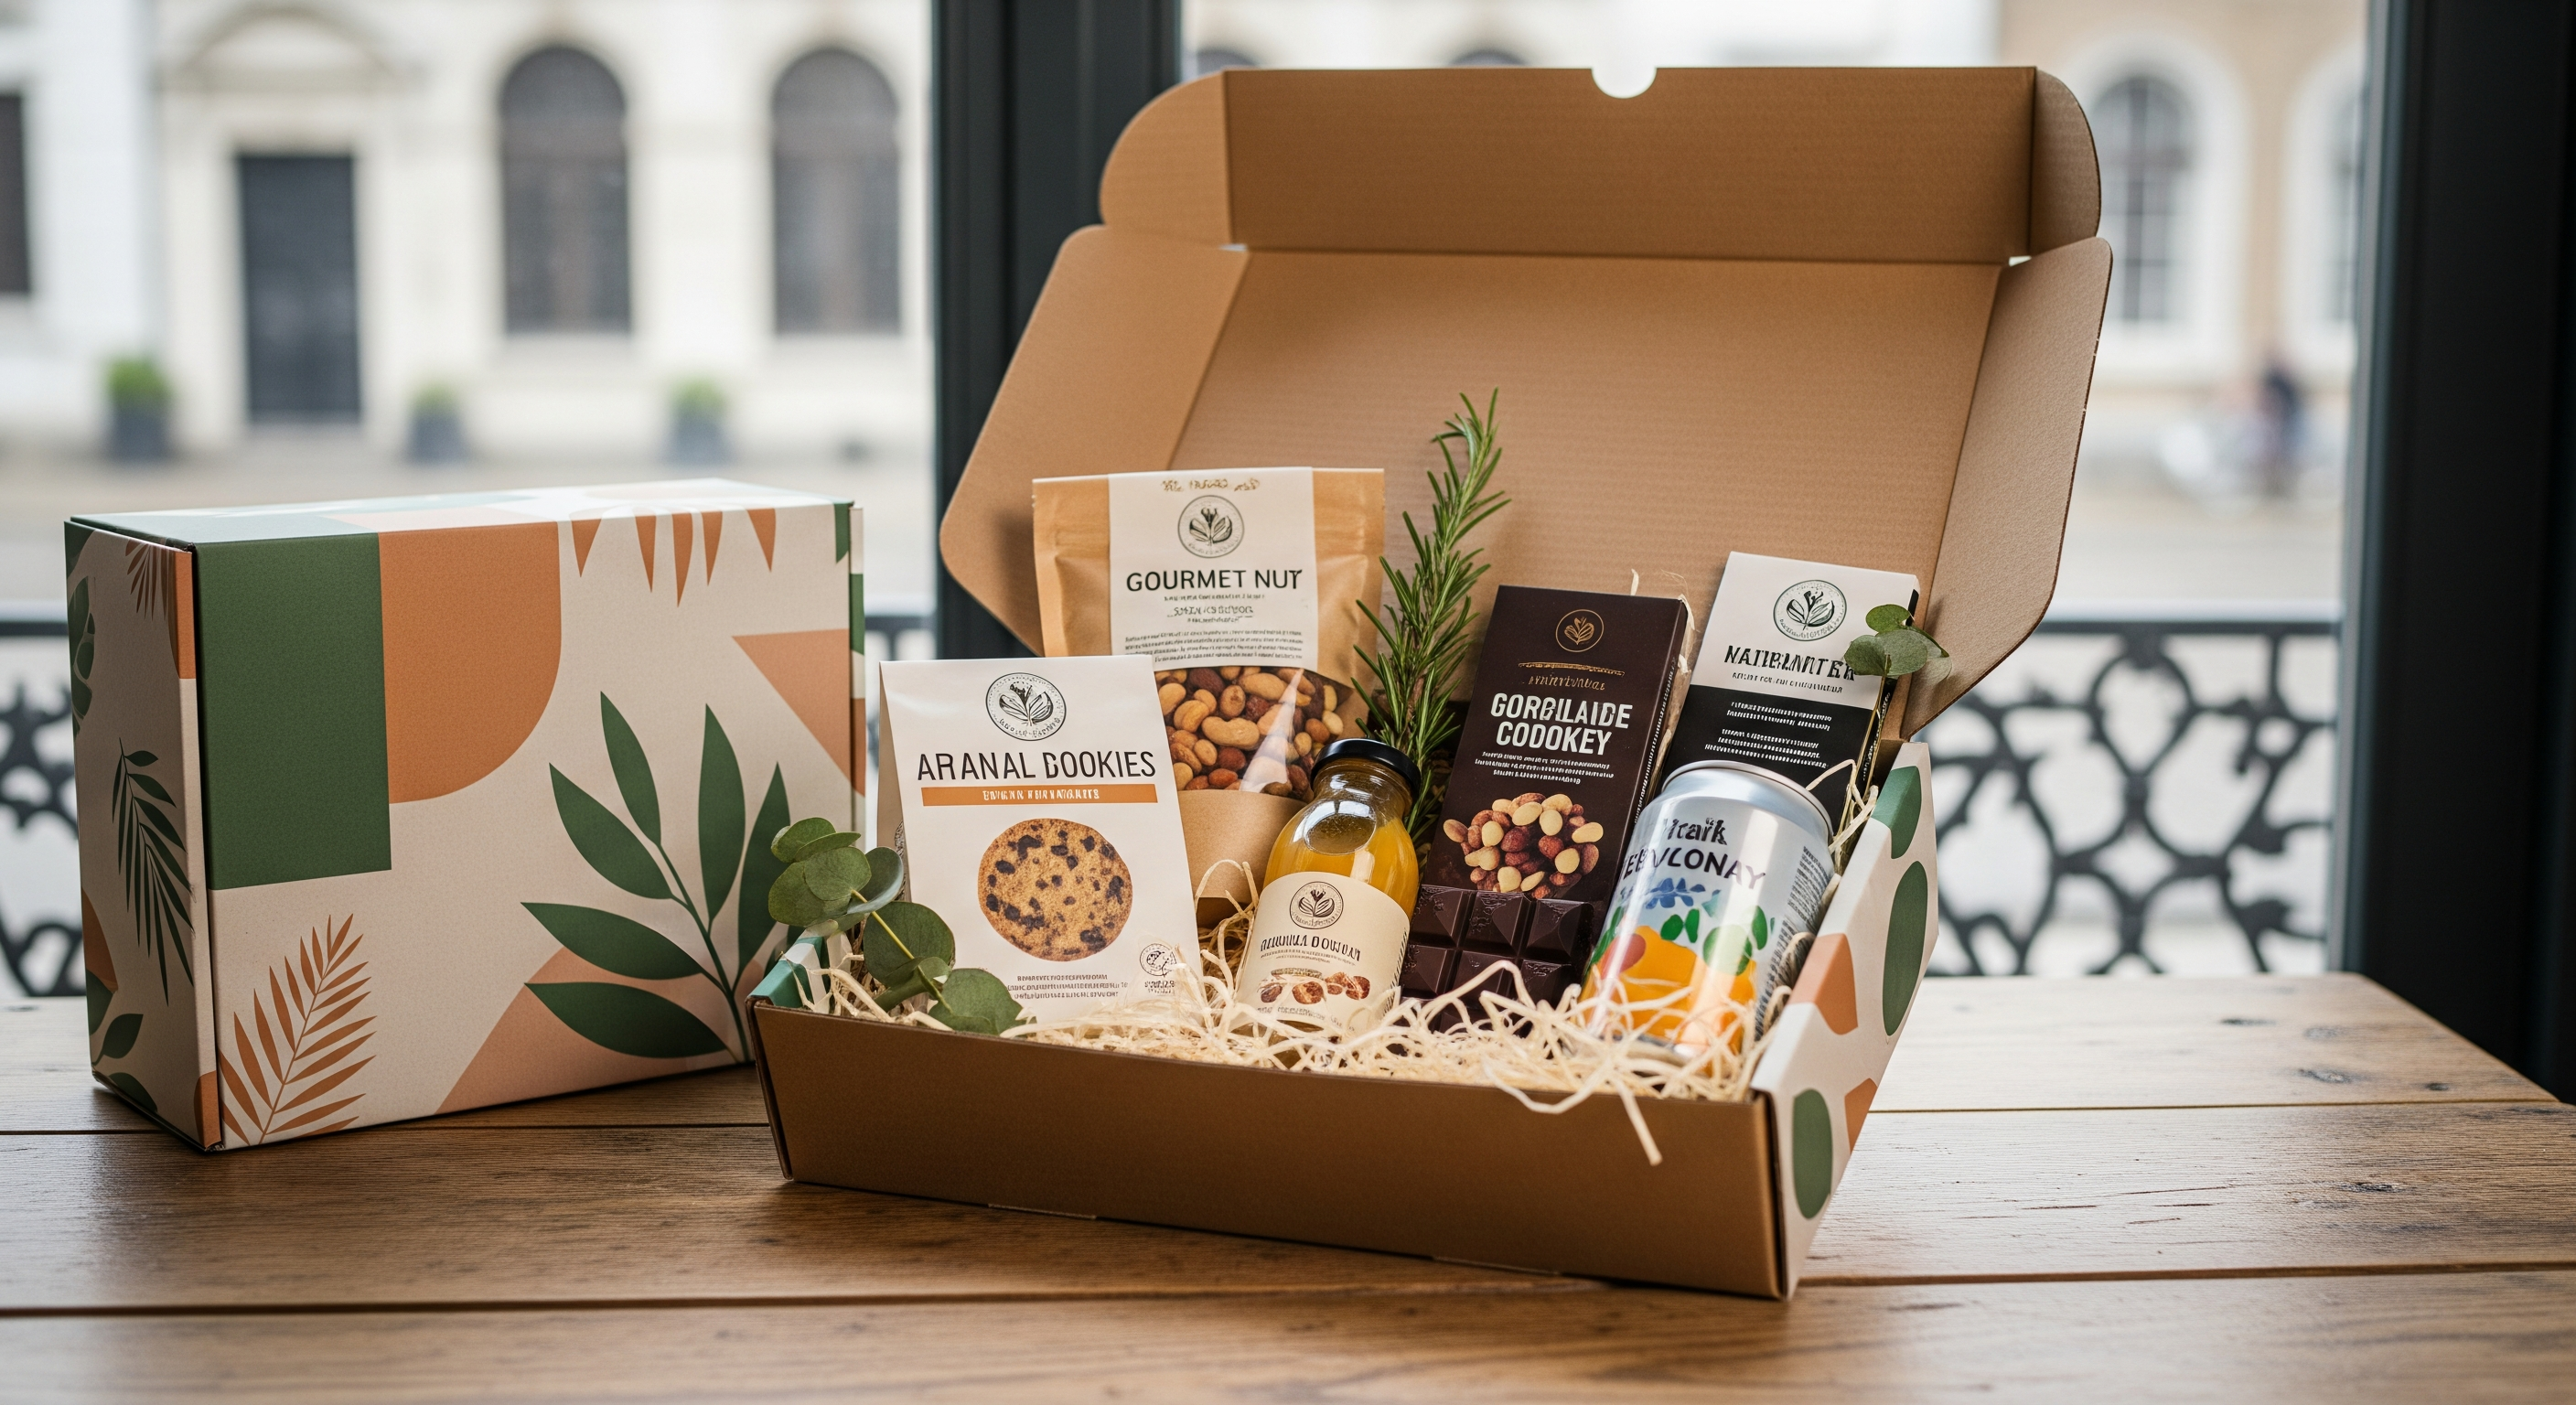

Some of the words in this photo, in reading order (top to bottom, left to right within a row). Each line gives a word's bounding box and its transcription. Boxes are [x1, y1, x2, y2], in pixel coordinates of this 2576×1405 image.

[1126, 570, 1247, 592] GOURMET
[1496, 721, 1613, 756] CODOKEY
[918, 752, 1036, 780] ARANAL
